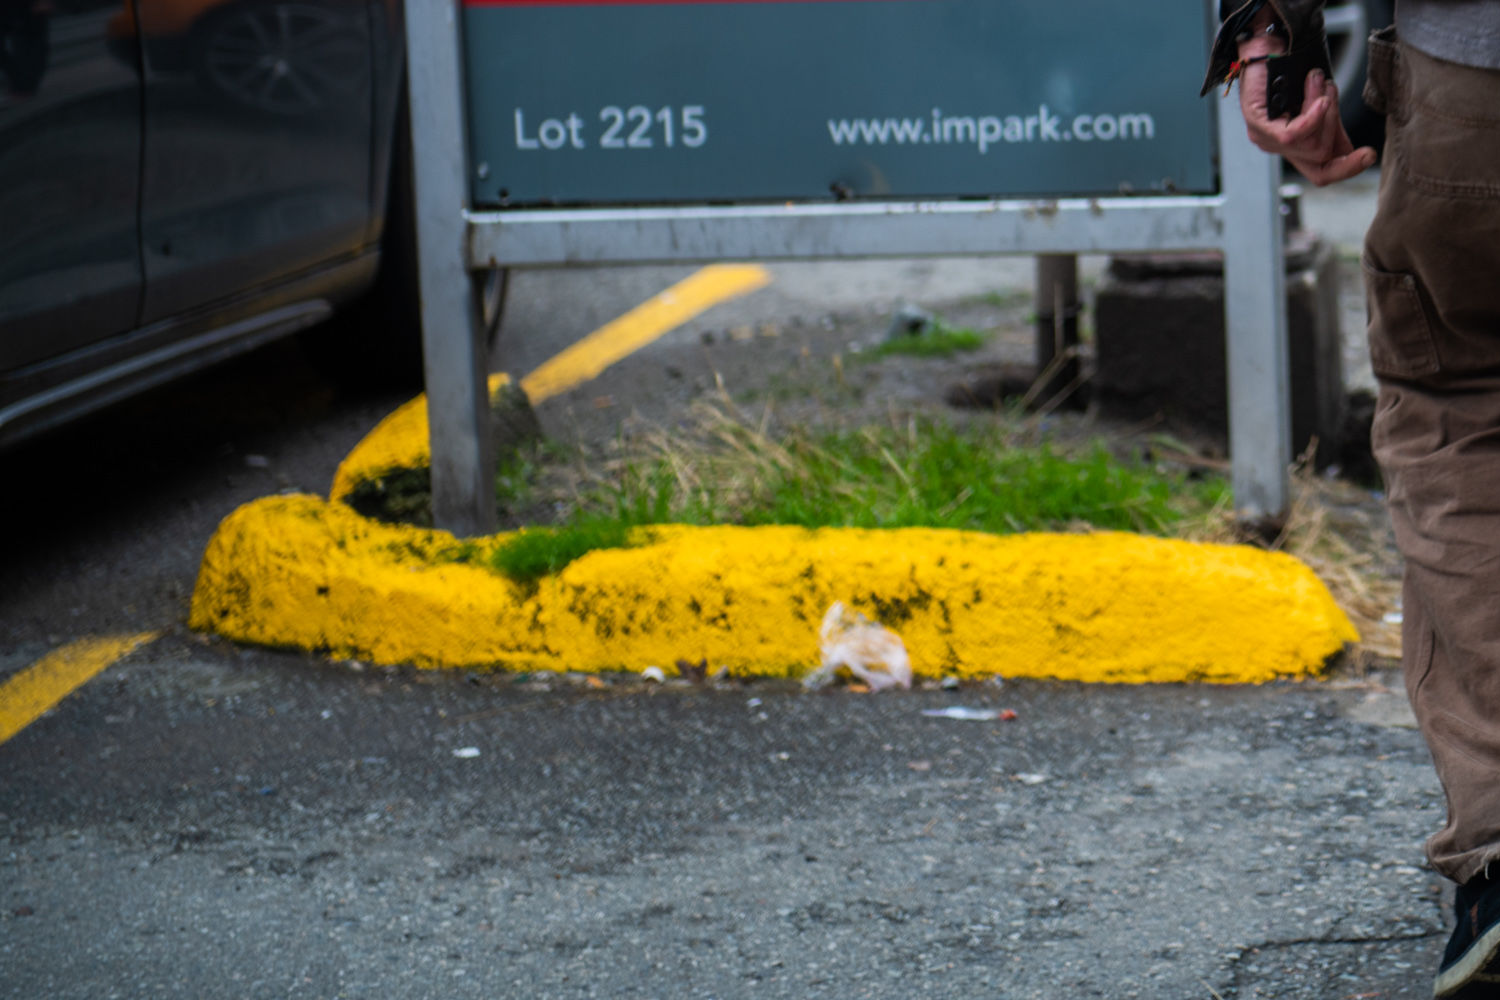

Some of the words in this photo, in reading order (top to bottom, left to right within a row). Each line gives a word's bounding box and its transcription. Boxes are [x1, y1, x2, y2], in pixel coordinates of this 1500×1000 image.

[514, 107, 585, 149] Lot
[599, 105, 707, 148] 2215
[827, 104, 1155, 153] www.impark.com
